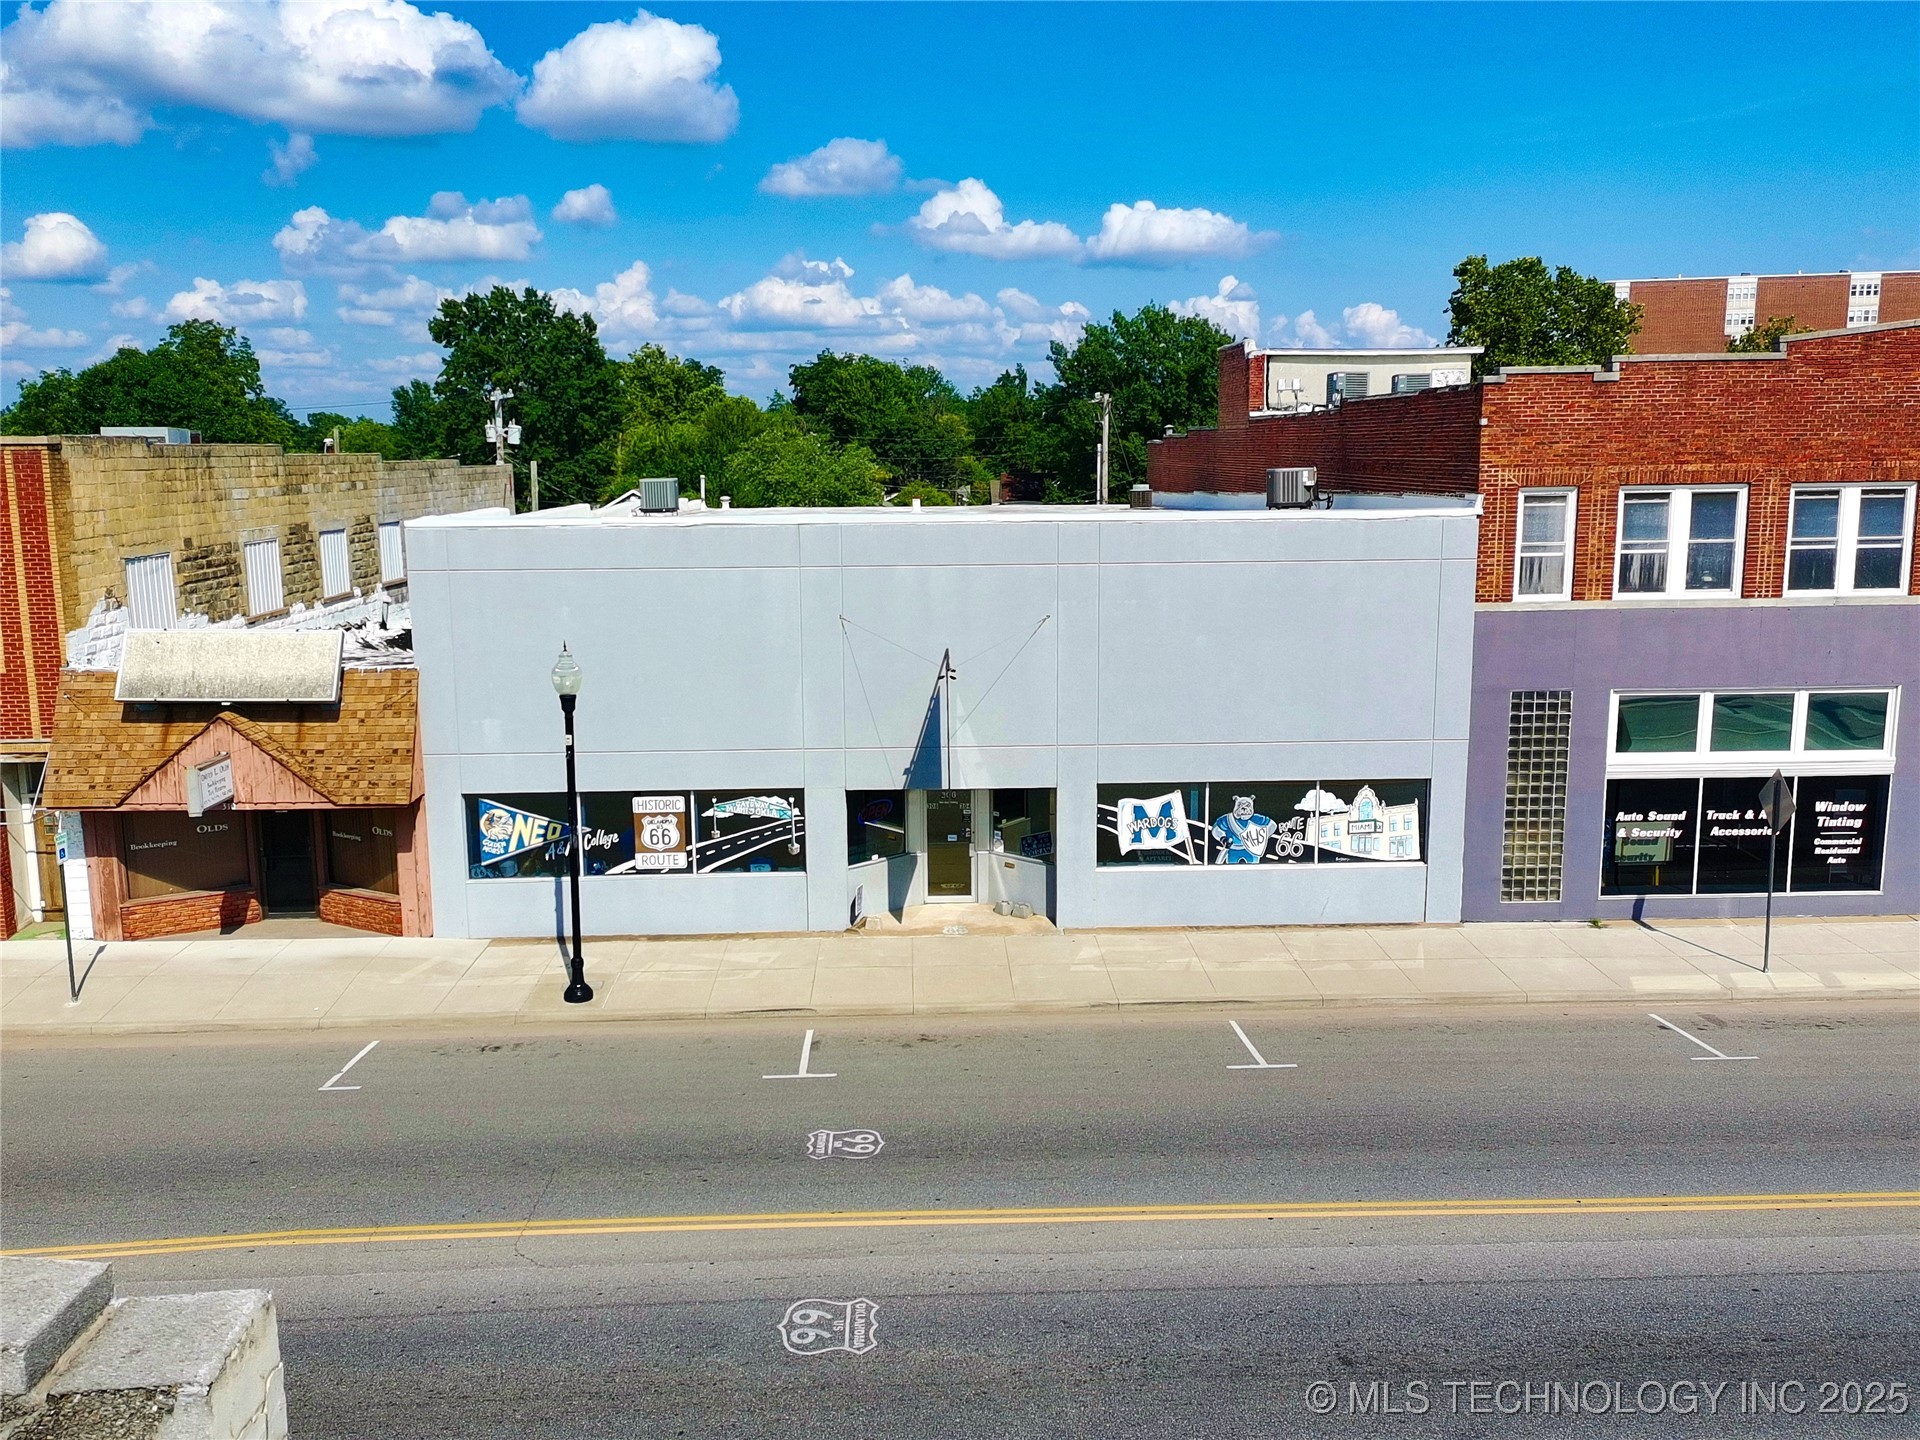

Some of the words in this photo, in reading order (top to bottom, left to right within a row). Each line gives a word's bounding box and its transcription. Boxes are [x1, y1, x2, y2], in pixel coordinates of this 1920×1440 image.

[637, 800, 681, 811] HISTORIC
[1814, 801, 1867, 812] Window
[1615, 811, 1644, 821] Auto
[1647, 811, 1687, 821] Sound
[1706, 810, 1741, 820] Truck
[1744, 809, 1754, 819] &
[1127, 817, 1179, 834] WARDOGS
[1129, 799, 1177, 845] M
[1278, 816, 1305, 833] ROUTE
[1351, 823, 1373, 831] MIAMI
[1817, 816, 1863, 828] Tinting
[196, 824, 229, 834] OLDS
[372, 826, 393, 837] OLDS
[508, 813, 562, 853] NEO
[1617, 828, 1627, 837] &
[1631, 827, 1683, 839] Security
[1710, 826, 1780, 836] Accessorie
[584, 829, 619, 850] College
[650, 828, 671, 846] 66
[1242, 828, 1266, 848] MHS
[1813, 837, 1863, 845] Commercial
[130, 840, 177, 851] Bookkeeping
[1275, 831, 1304, 857] 66
[1814, 846, 1861, 854] Residential
[641, 854, 679, 866] ROUTE
[1826, 856, 1847, 864] Auto
[842, 1134, 876, 1153] 66
[790, 1309, 833, 1345] 66
[833, 1320, 844, 1331] US
[853, 1302, 867, 1349] OKLAHOMA
